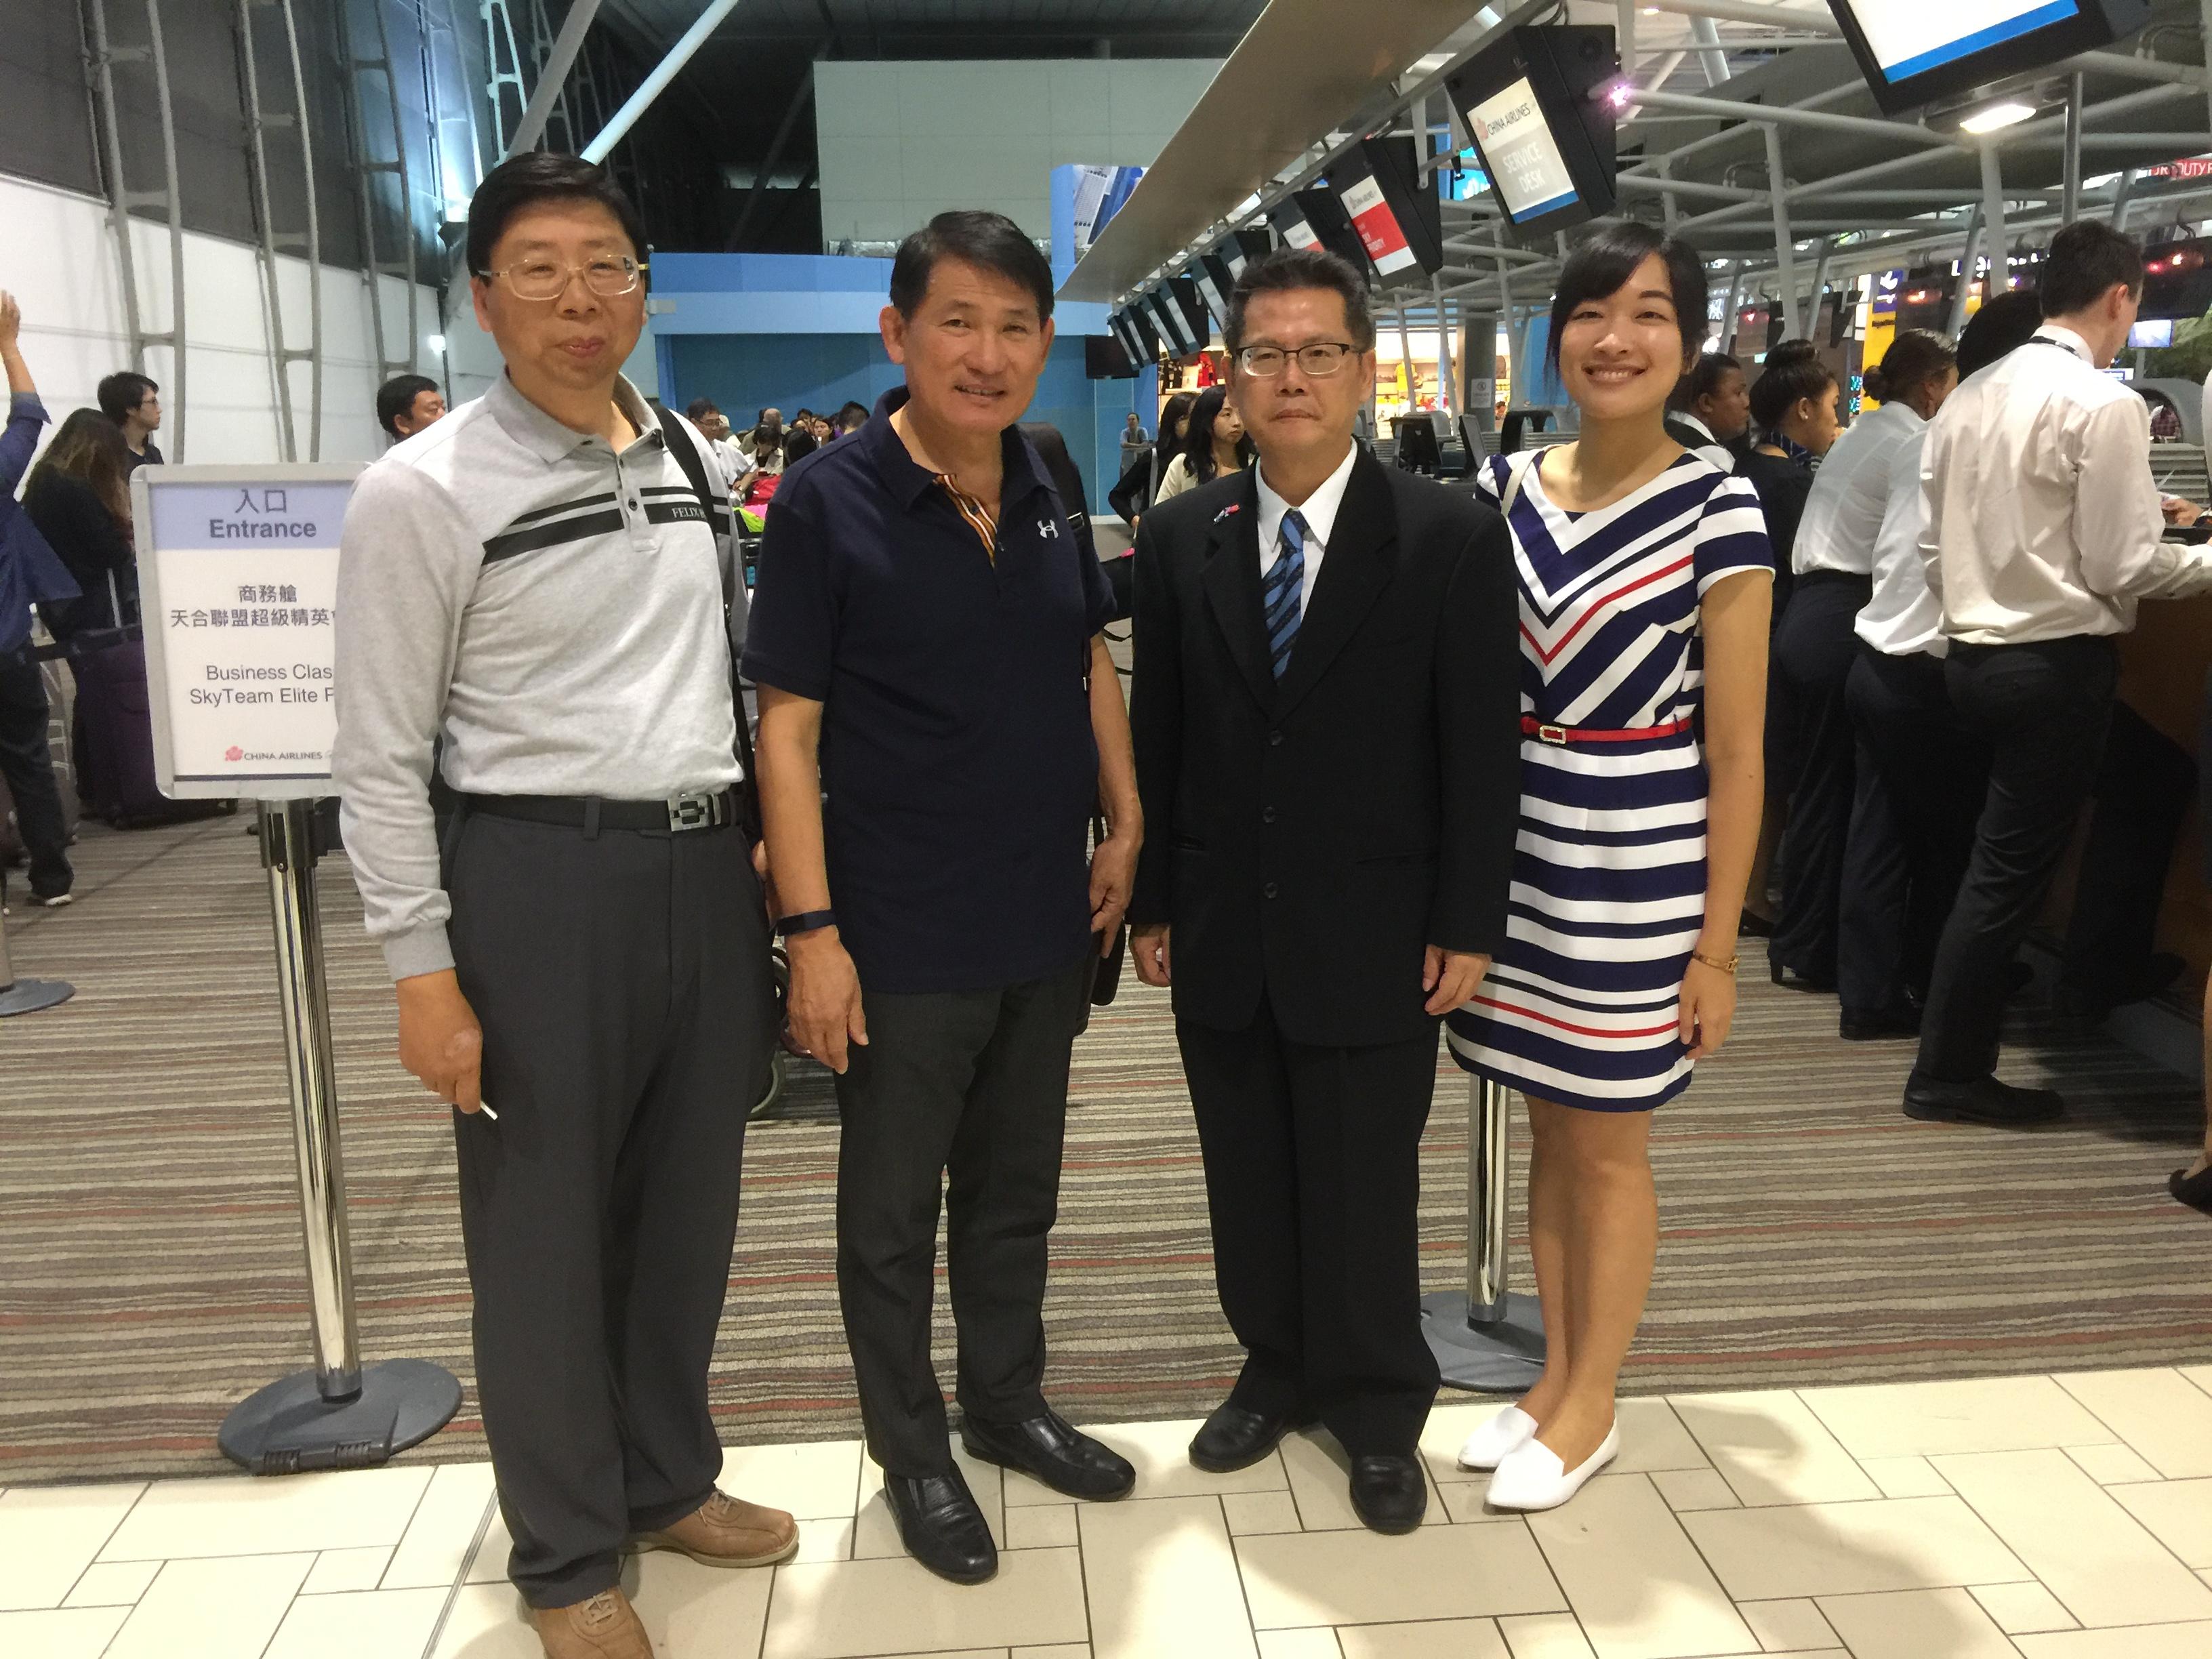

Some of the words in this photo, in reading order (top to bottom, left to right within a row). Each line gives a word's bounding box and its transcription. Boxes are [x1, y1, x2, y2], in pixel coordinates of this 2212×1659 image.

[1502, 141, 1543, 174] SERVICE
[1518, 167, 1546, 193] DESK
[234, 488, 287, 514] 入口
[671, 507, 700, 518] FELIX
[209, 518, 316, 538] Entrance
[238, 584, 298, 603] 商務艙
[170, 608, 336, 628] 天合聯盟超級精英
[206, 663, 287, 680] Business
[293, 663, 333, 680] Clas
[190, 688, 274, 708] SkyTeam
[280, 687, 318, 703] Elite
[244, 752, 276, 760] CHINA
[279, 751, 323, 760] AIRLINES
